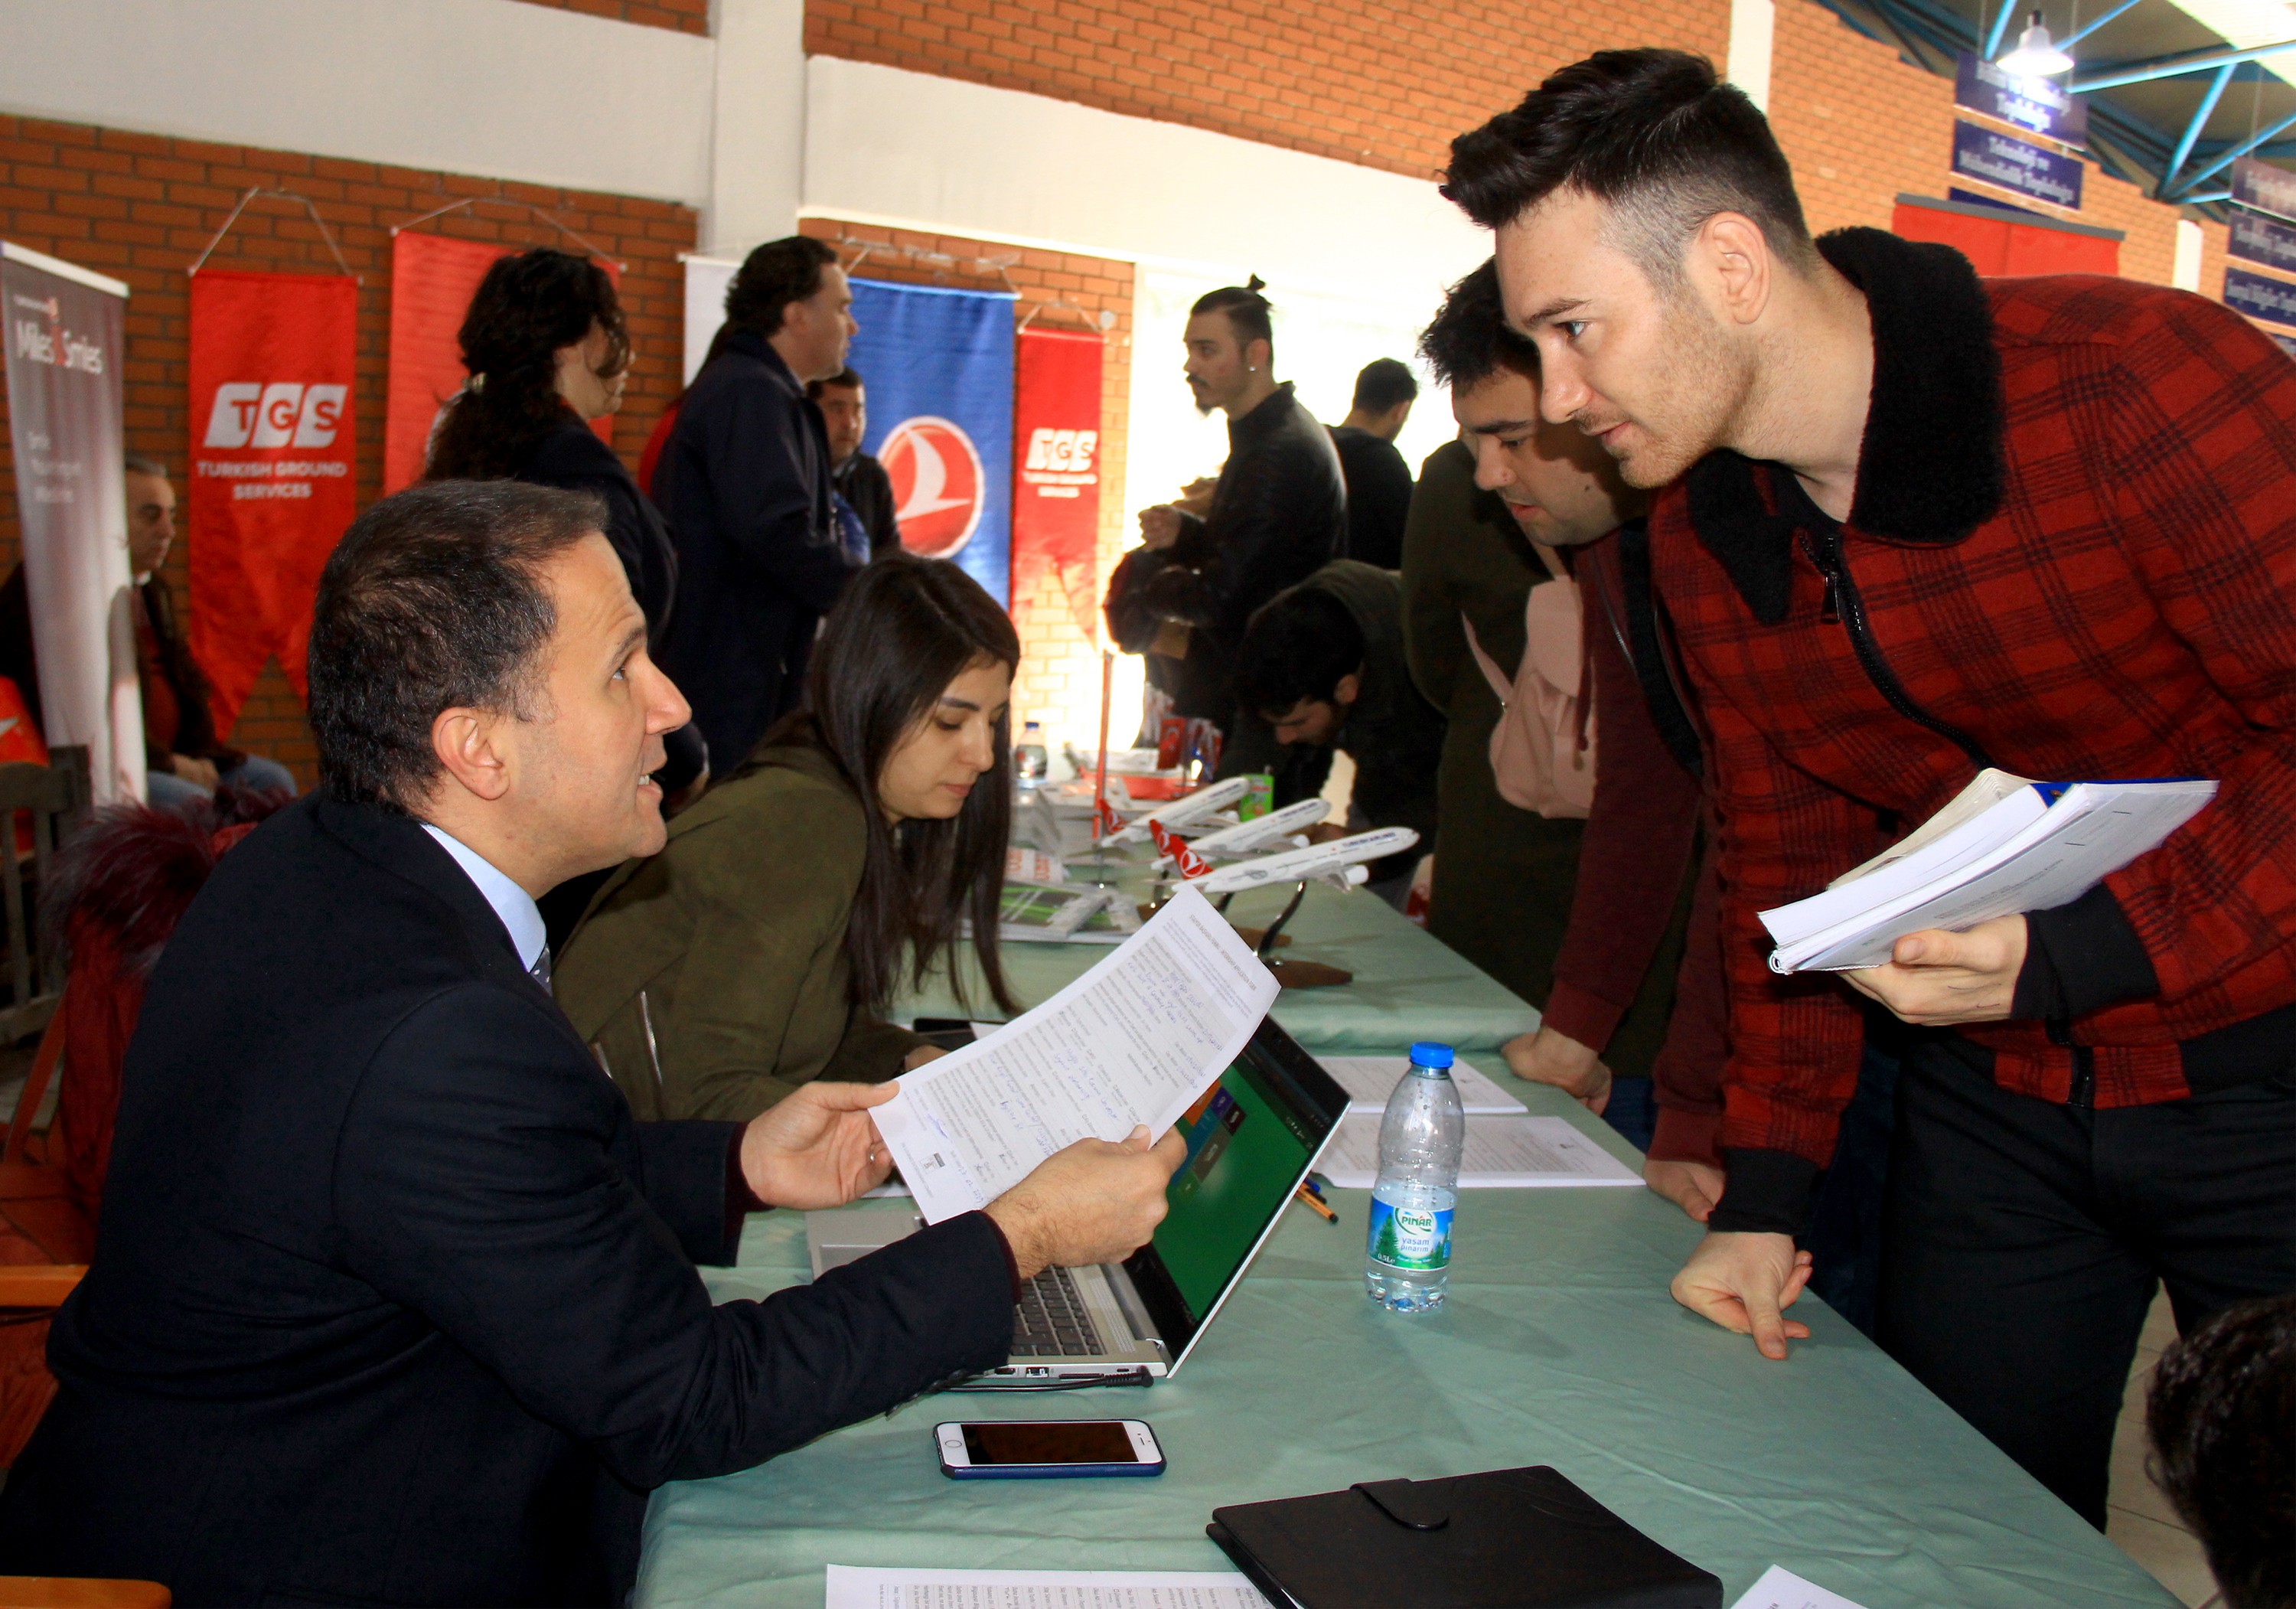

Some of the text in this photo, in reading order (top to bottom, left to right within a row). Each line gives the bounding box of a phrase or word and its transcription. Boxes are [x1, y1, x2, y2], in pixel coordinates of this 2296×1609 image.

[197, 461, 348, 477] TURKISH GROUND
[233, 483, 312, 500] SERVICES
[1402, 1216, 1432, 1226] PINAR
